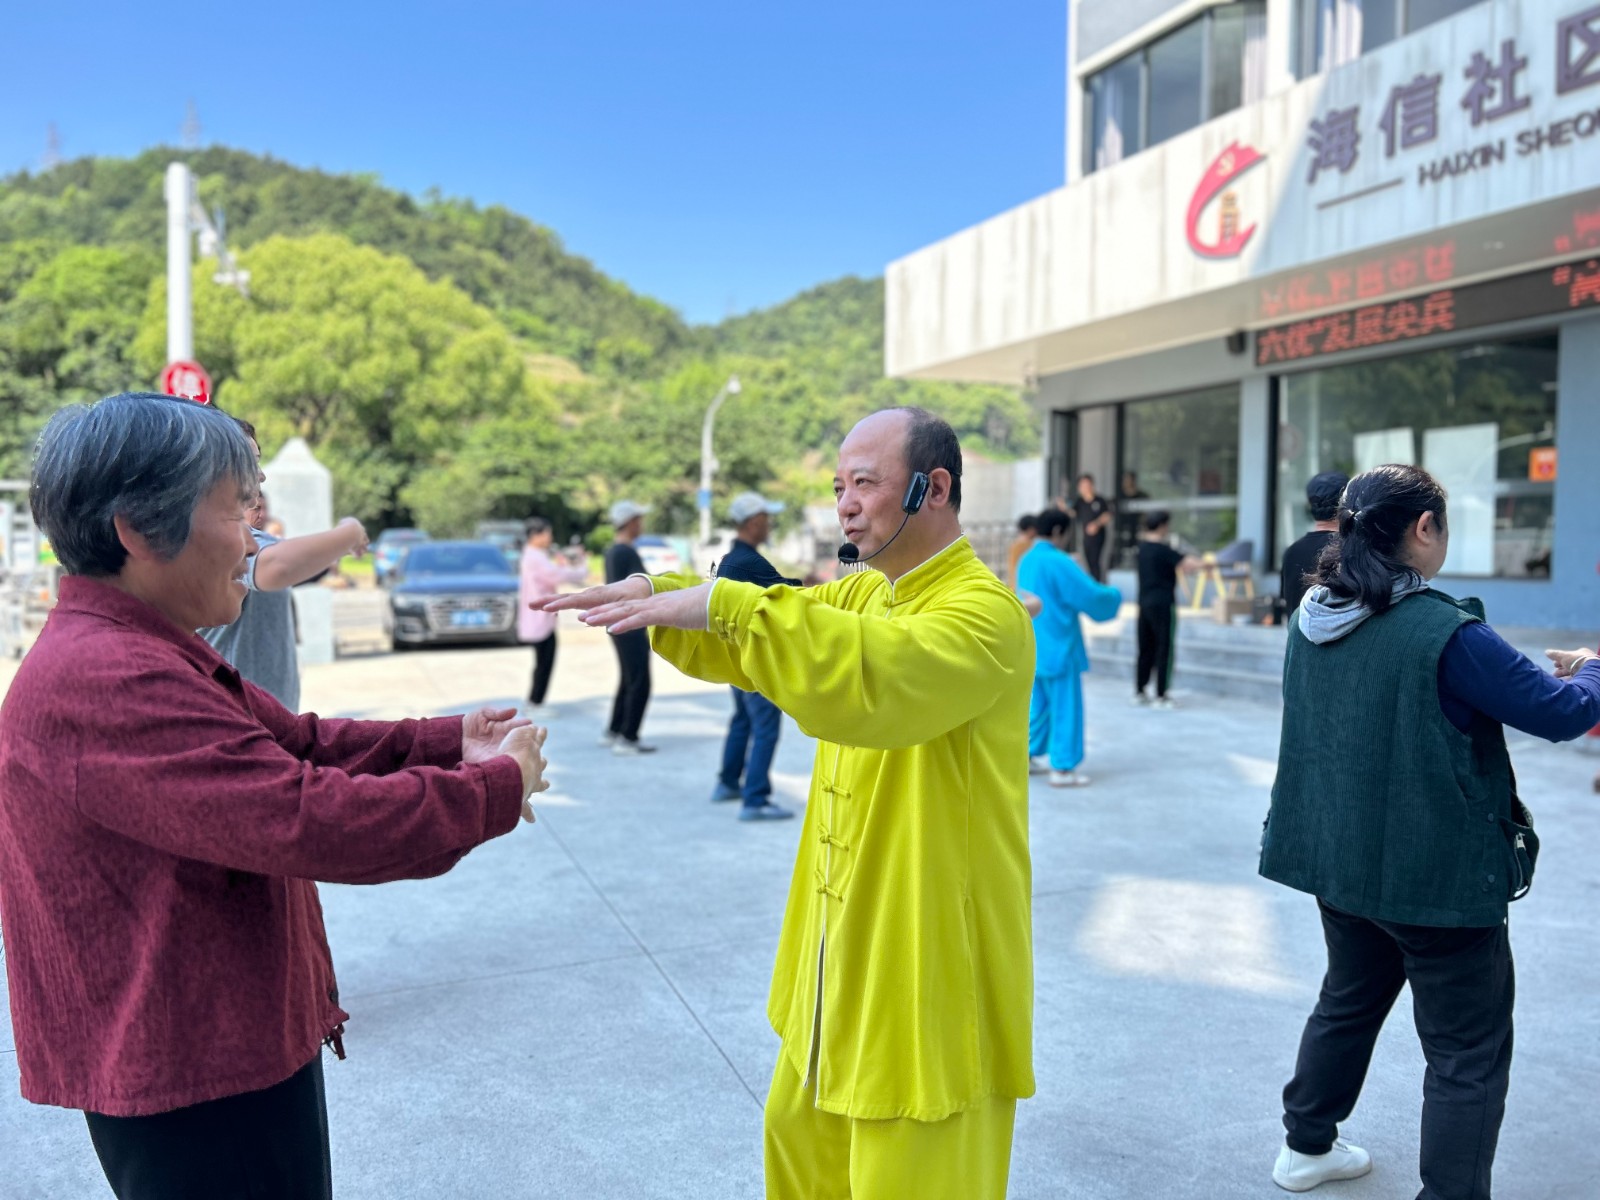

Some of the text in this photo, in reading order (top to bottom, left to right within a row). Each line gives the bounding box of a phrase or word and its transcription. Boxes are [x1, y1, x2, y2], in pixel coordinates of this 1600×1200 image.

[1306, 4, 1600, 184] 海信社区
[1418, 107, 1600, 187] HAIXIN SHEQ
